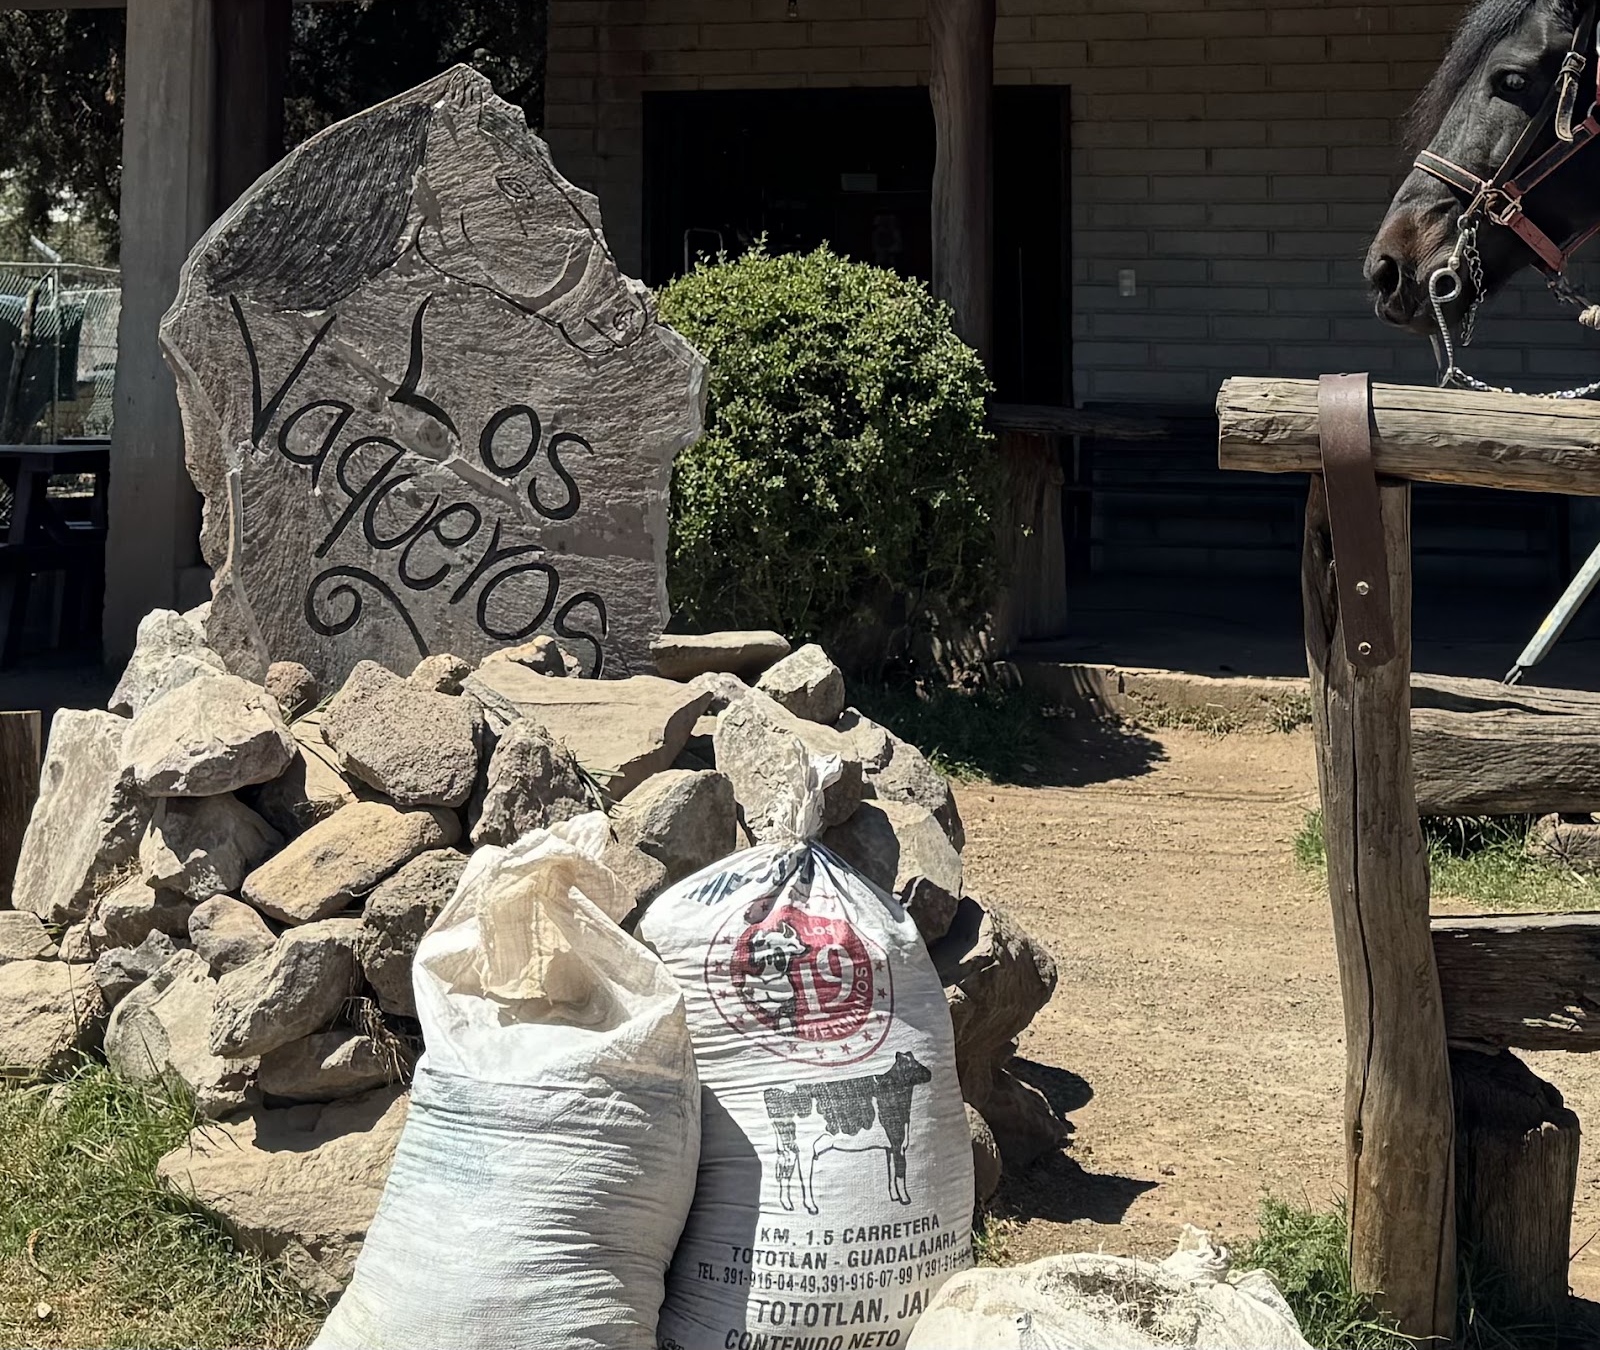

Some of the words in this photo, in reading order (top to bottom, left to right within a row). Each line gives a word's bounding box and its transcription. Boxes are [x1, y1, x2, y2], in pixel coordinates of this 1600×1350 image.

[803, 925, 834, 937] LOS
[797, 944, 854, 1021] 19
[761, 1227, 796, 1247] KM.
[806, 1229, 834, 1246] 1.5
[842, 1214, 940, 1244] CARRETERA
[732, 1246, 828, 1270] TOTOTLAN
[847, 1231, 957, 1268] GUADALAJARA
[699, 1262, 720, 1282] TEL.
[916, 1263, 924, 1281] Y
[756, 1298, 889, 1327] TOTOTLAN,
[725, 1328, 843, 1350] CONTENIDO
[848, 1329, 901, 1349] NETO
